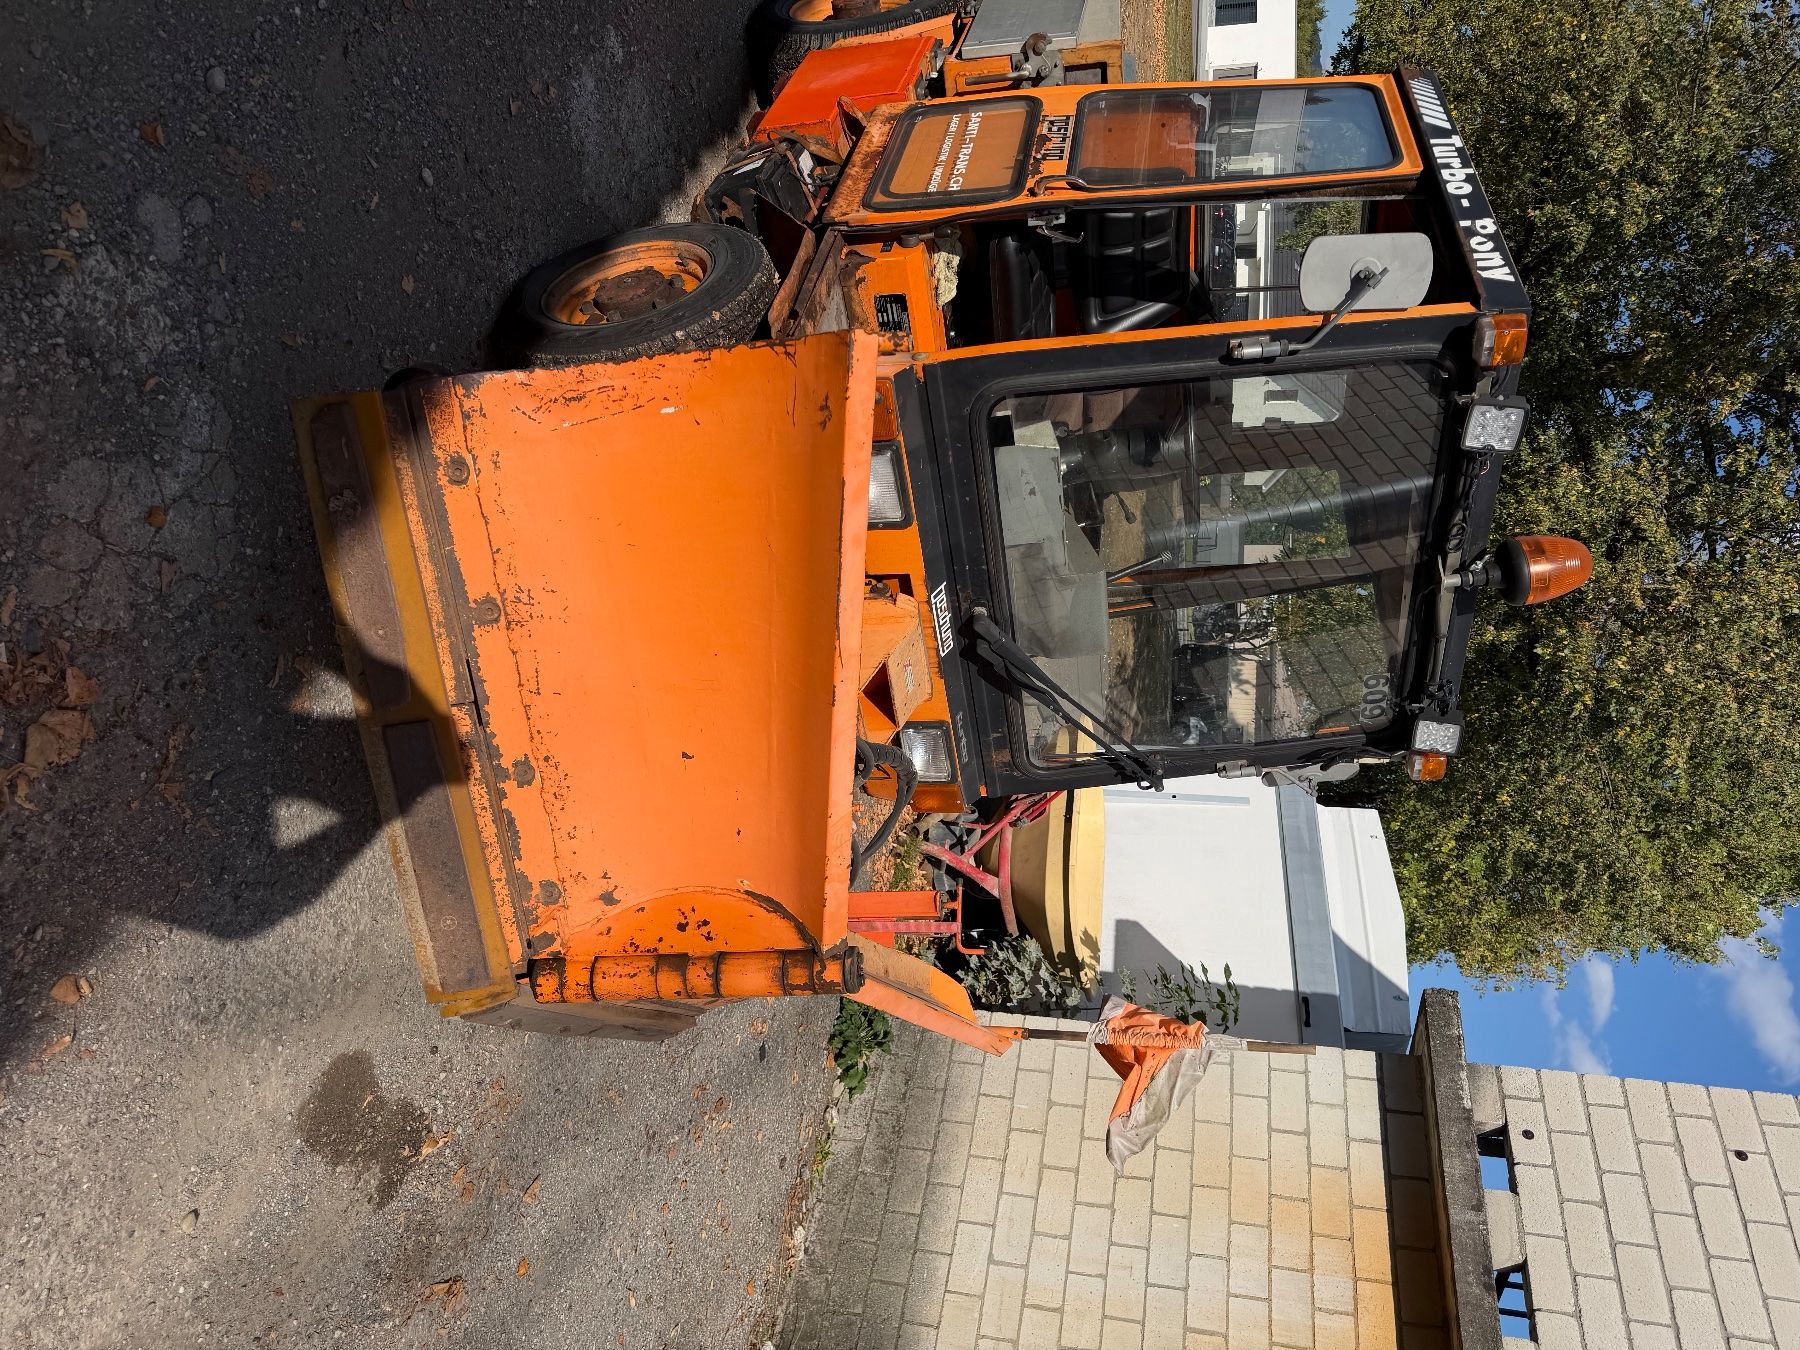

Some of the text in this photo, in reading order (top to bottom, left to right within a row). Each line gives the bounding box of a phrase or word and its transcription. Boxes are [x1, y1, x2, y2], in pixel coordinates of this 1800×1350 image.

[949, 114, 961, 132] LAGER
[927, 165, 944, 193] UMZÜGE
[948, 112, 983, 191] SANTI-TRANS.CH
[1458, 218, 1516, 282] Pony
[930, 581, 954, 658] boschung
[1360, 674, 1390, 720] 609
